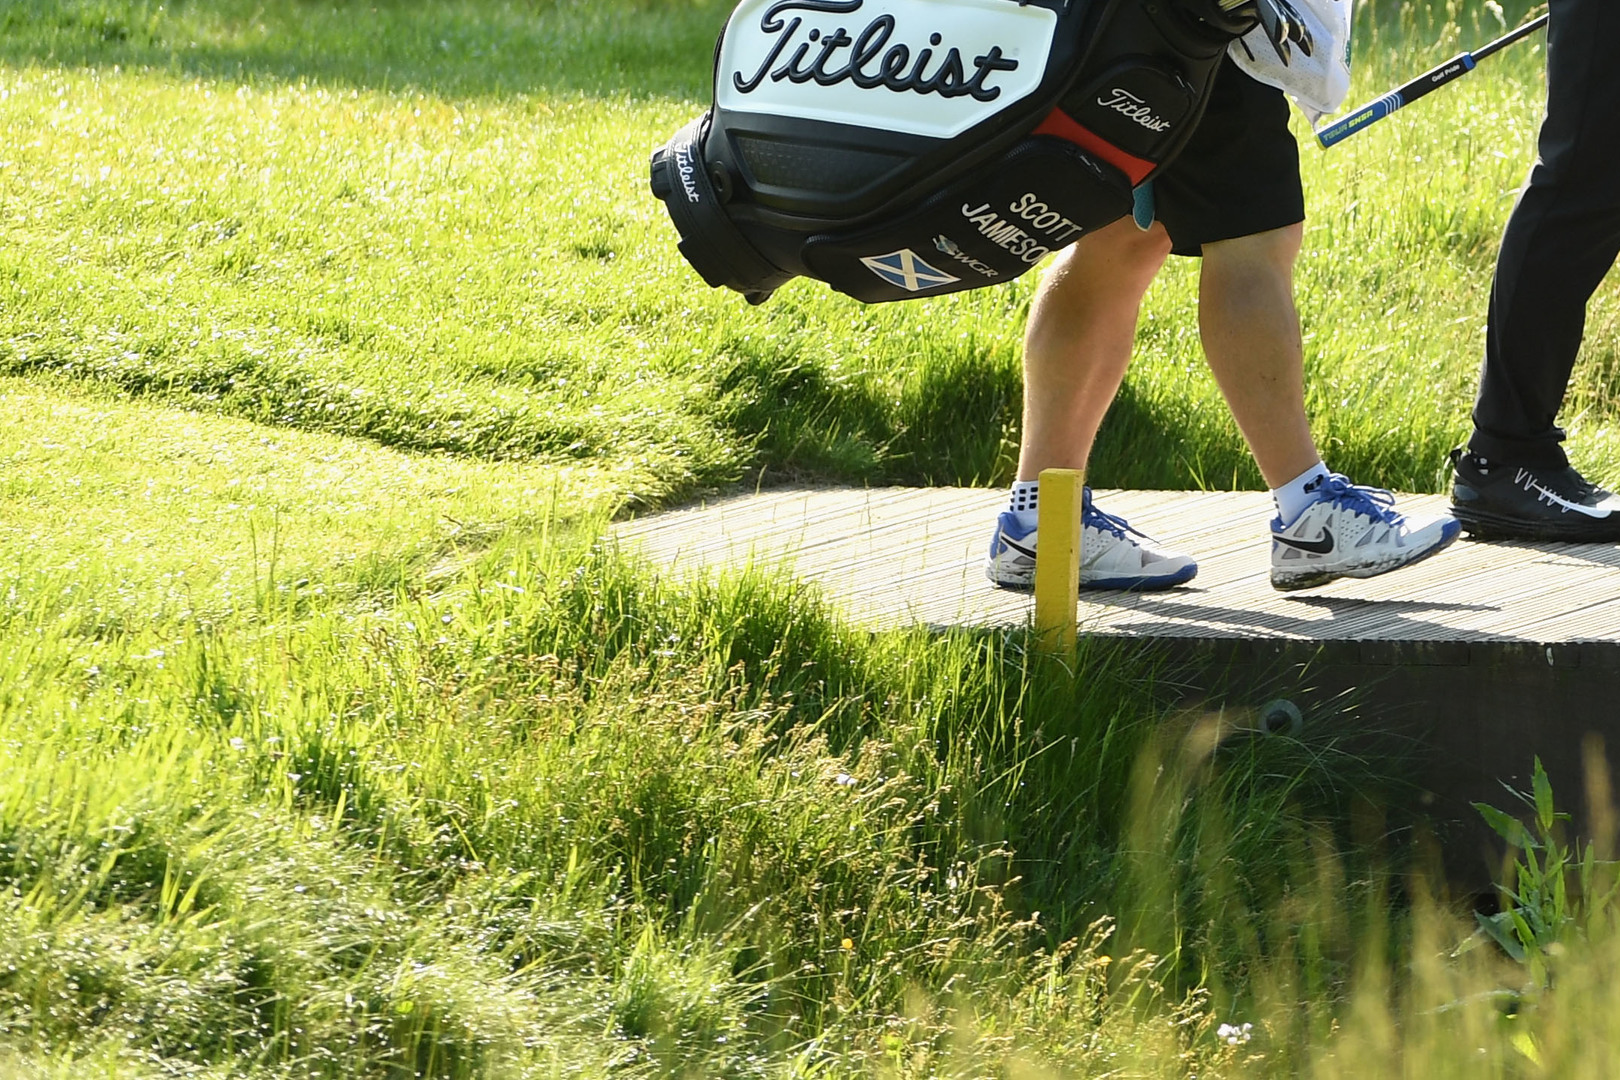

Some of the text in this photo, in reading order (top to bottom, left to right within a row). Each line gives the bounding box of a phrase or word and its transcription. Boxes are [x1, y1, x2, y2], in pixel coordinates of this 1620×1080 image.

[1097, 88, 1171, 132] Titleist
[674, 142, 700, 203] Titleist
[961, 203, 1050, 266] JAMIESO
[1009, 192, 1083, 242] SCOTT
